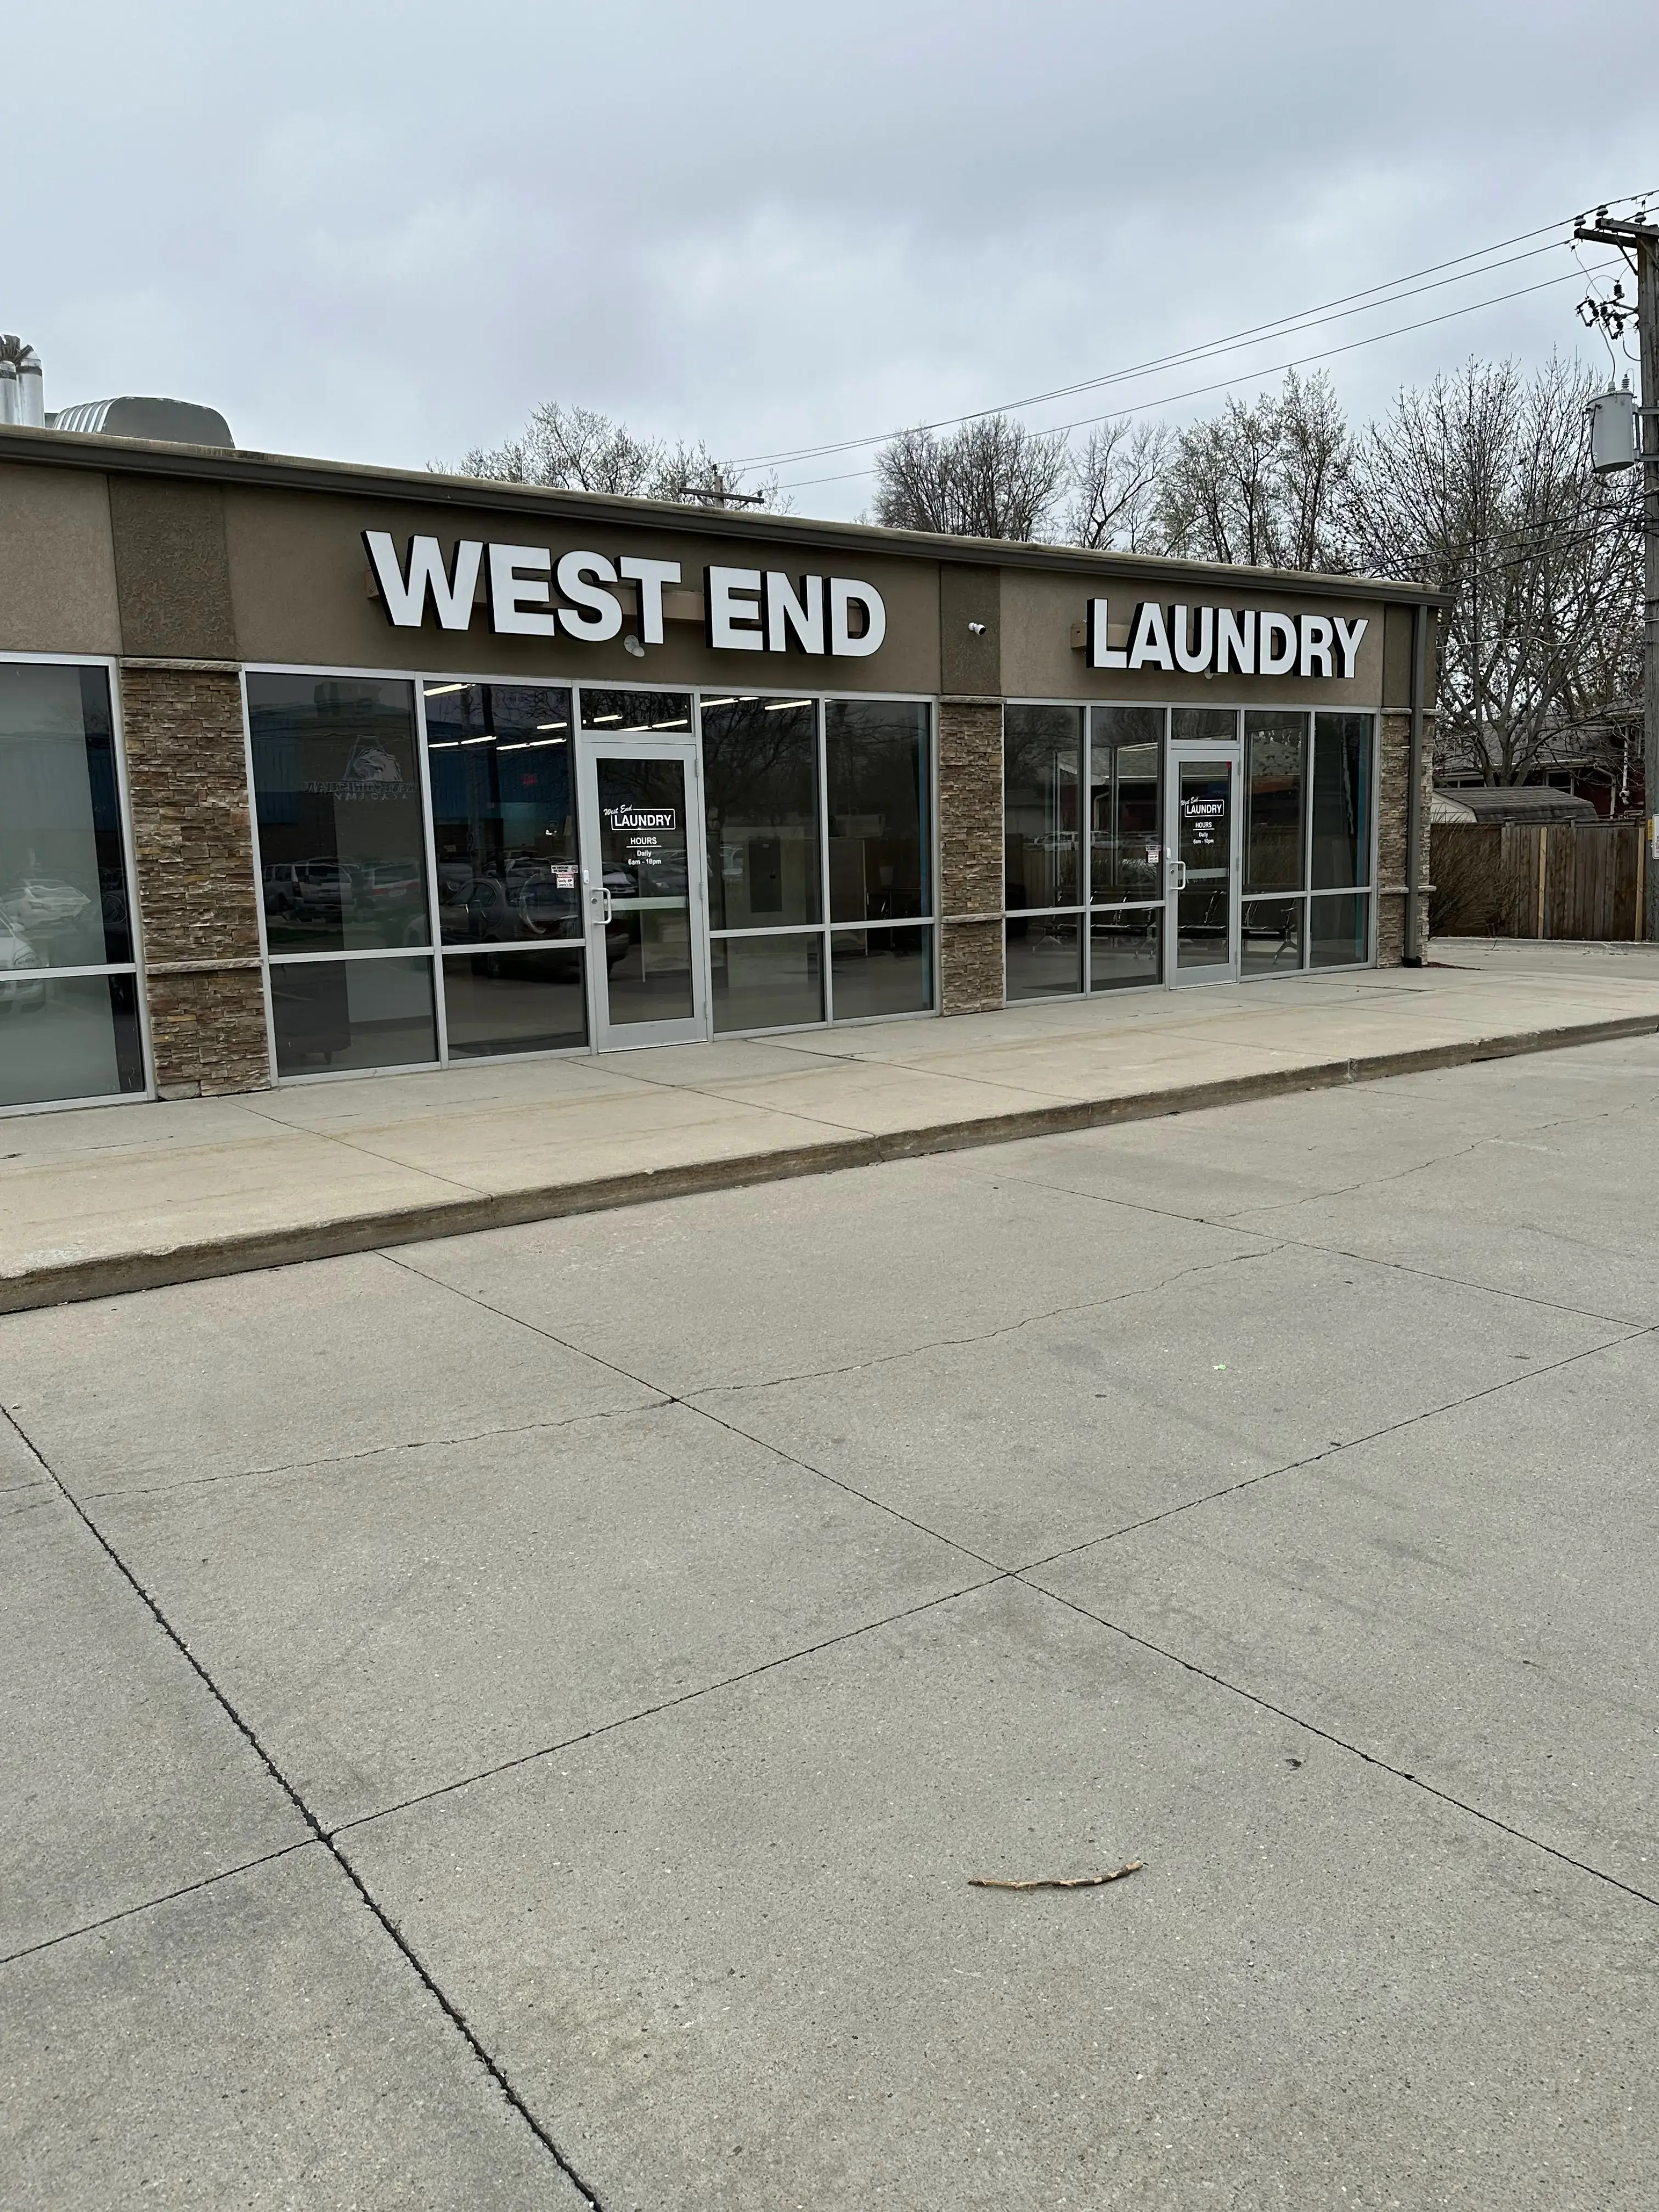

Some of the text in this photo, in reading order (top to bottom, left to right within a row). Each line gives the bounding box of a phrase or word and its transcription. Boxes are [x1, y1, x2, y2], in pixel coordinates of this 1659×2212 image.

[361, 529, 887, 657] WEST END
[1087, 598, 1369, 678] LAUNDRY
[603, 804, 633, 816] West End
[1187, 804, 1222, 814] LAUNDRY
[614, 814, 672, 827] LAUNDRY
